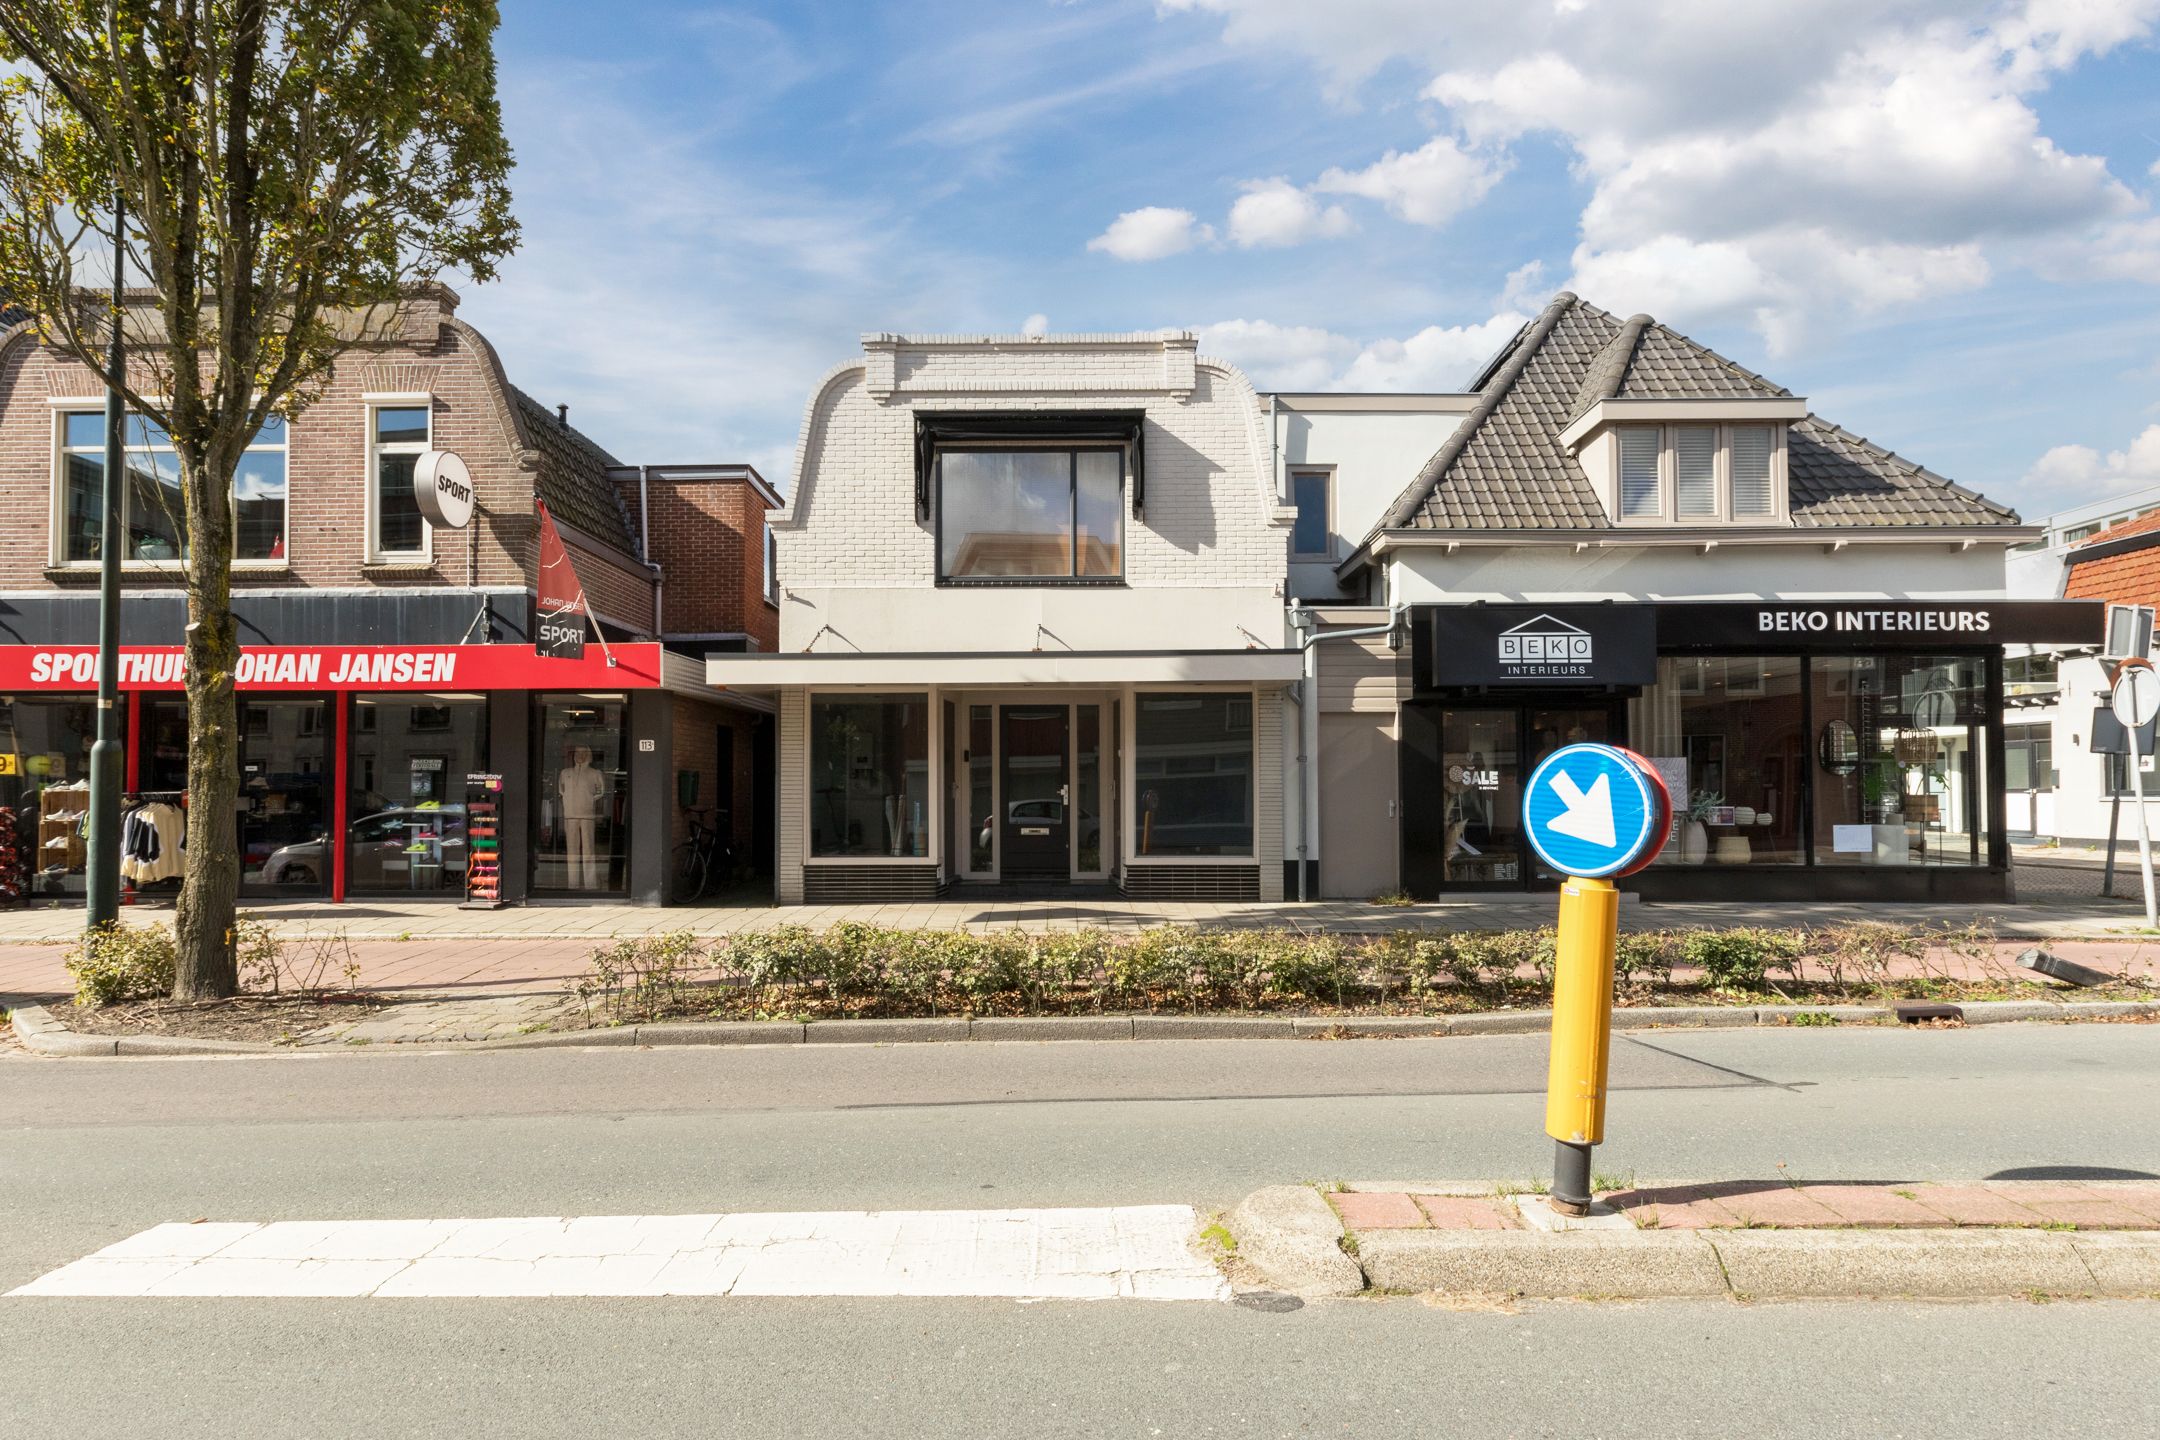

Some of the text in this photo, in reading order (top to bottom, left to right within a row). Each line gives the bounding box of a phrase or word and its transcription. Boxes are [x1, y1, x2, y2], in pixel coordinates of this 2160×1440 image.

[438, 474, 471, 503] SPORT
[1758, 611, 1990, 632] BEKO INTERIEURS
[540, 625, 584, 644] SPORT
[1504, 639, 1588, 654] BEKO
[235, 653, 322, 682] OHAN
[329, 653, 457, 683] JANSEN
[1508, 666, 1586, 675] INTERIEURS
[1462, 770, 1499, 785] SALE
